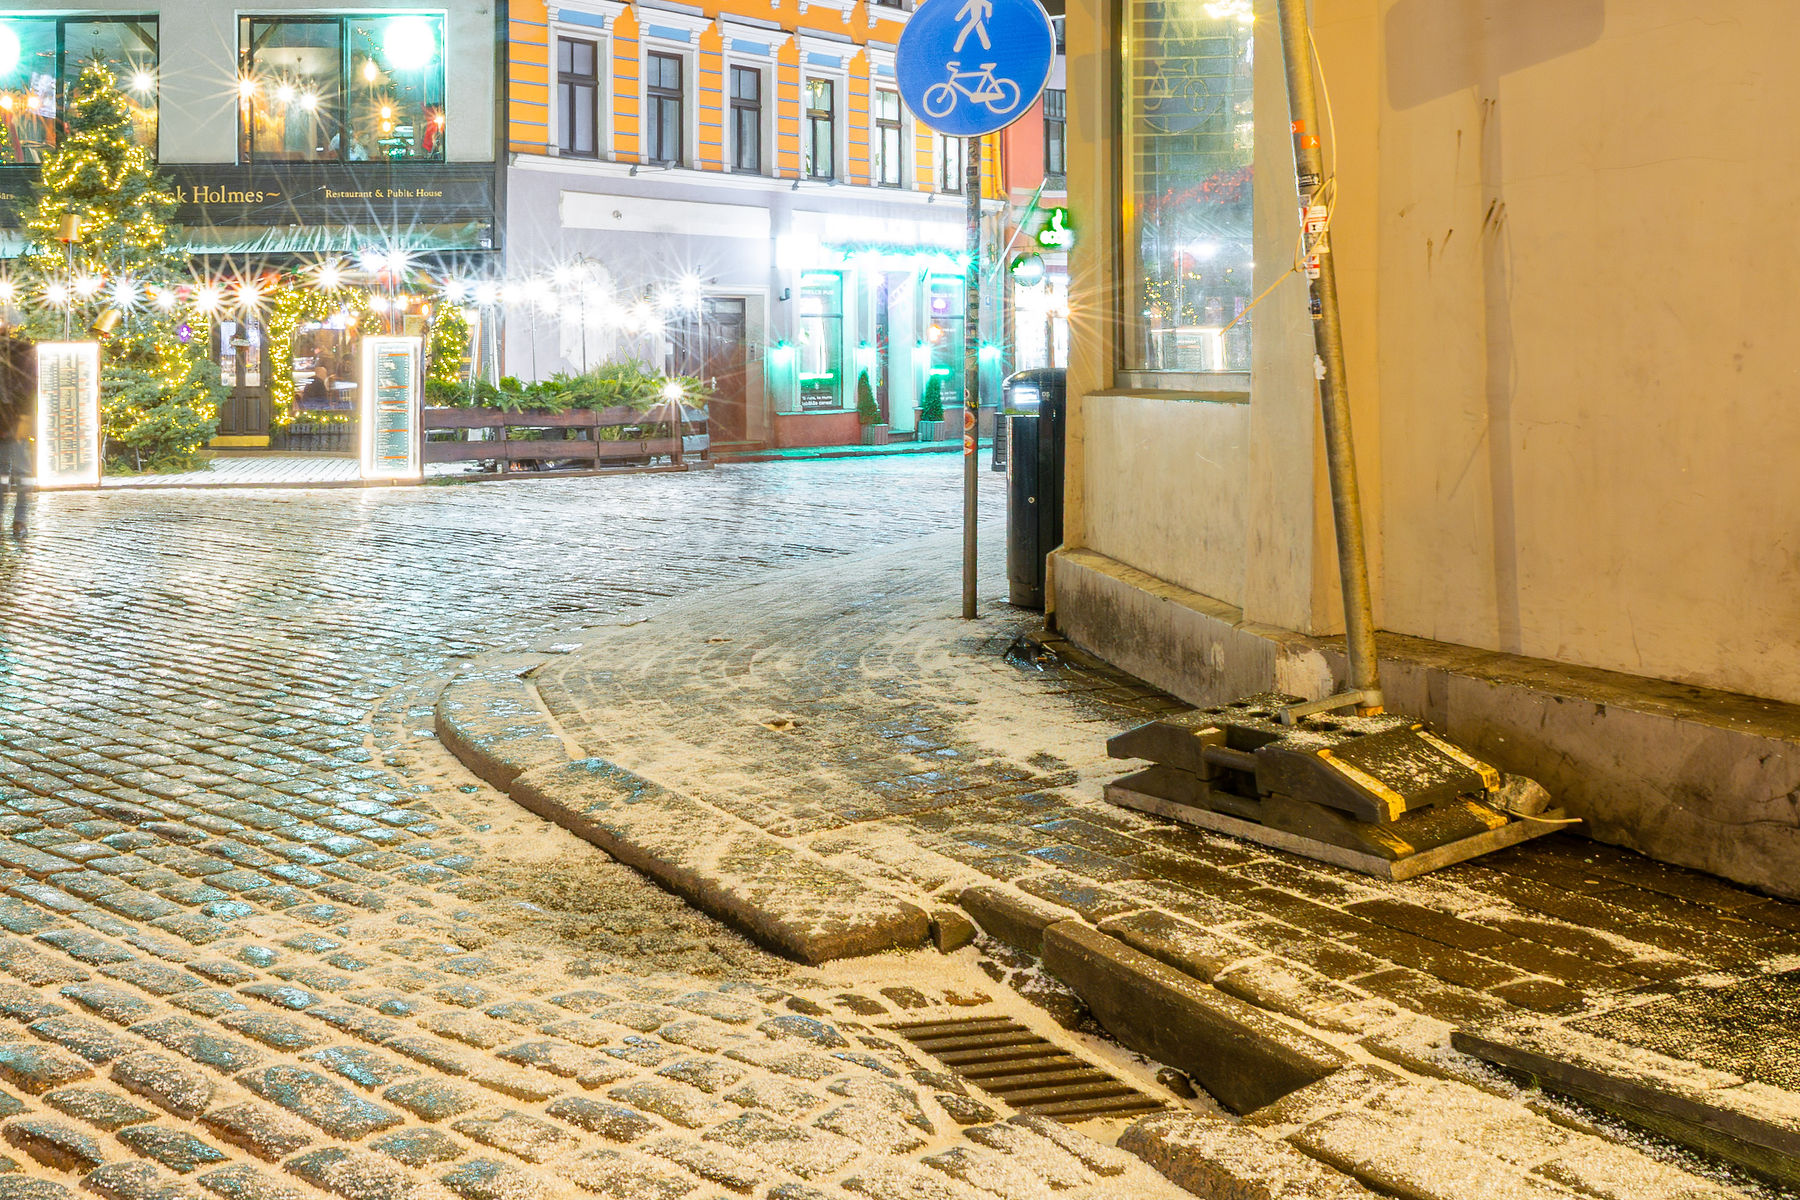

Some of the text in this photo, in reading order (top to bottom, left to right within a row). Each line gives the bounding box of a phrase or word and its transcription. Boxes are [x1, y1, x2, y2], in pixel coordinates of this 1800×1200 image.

[192, 185, 264, 204] Holmes
[325, 188, 443, 198] Restaurant & Public House
